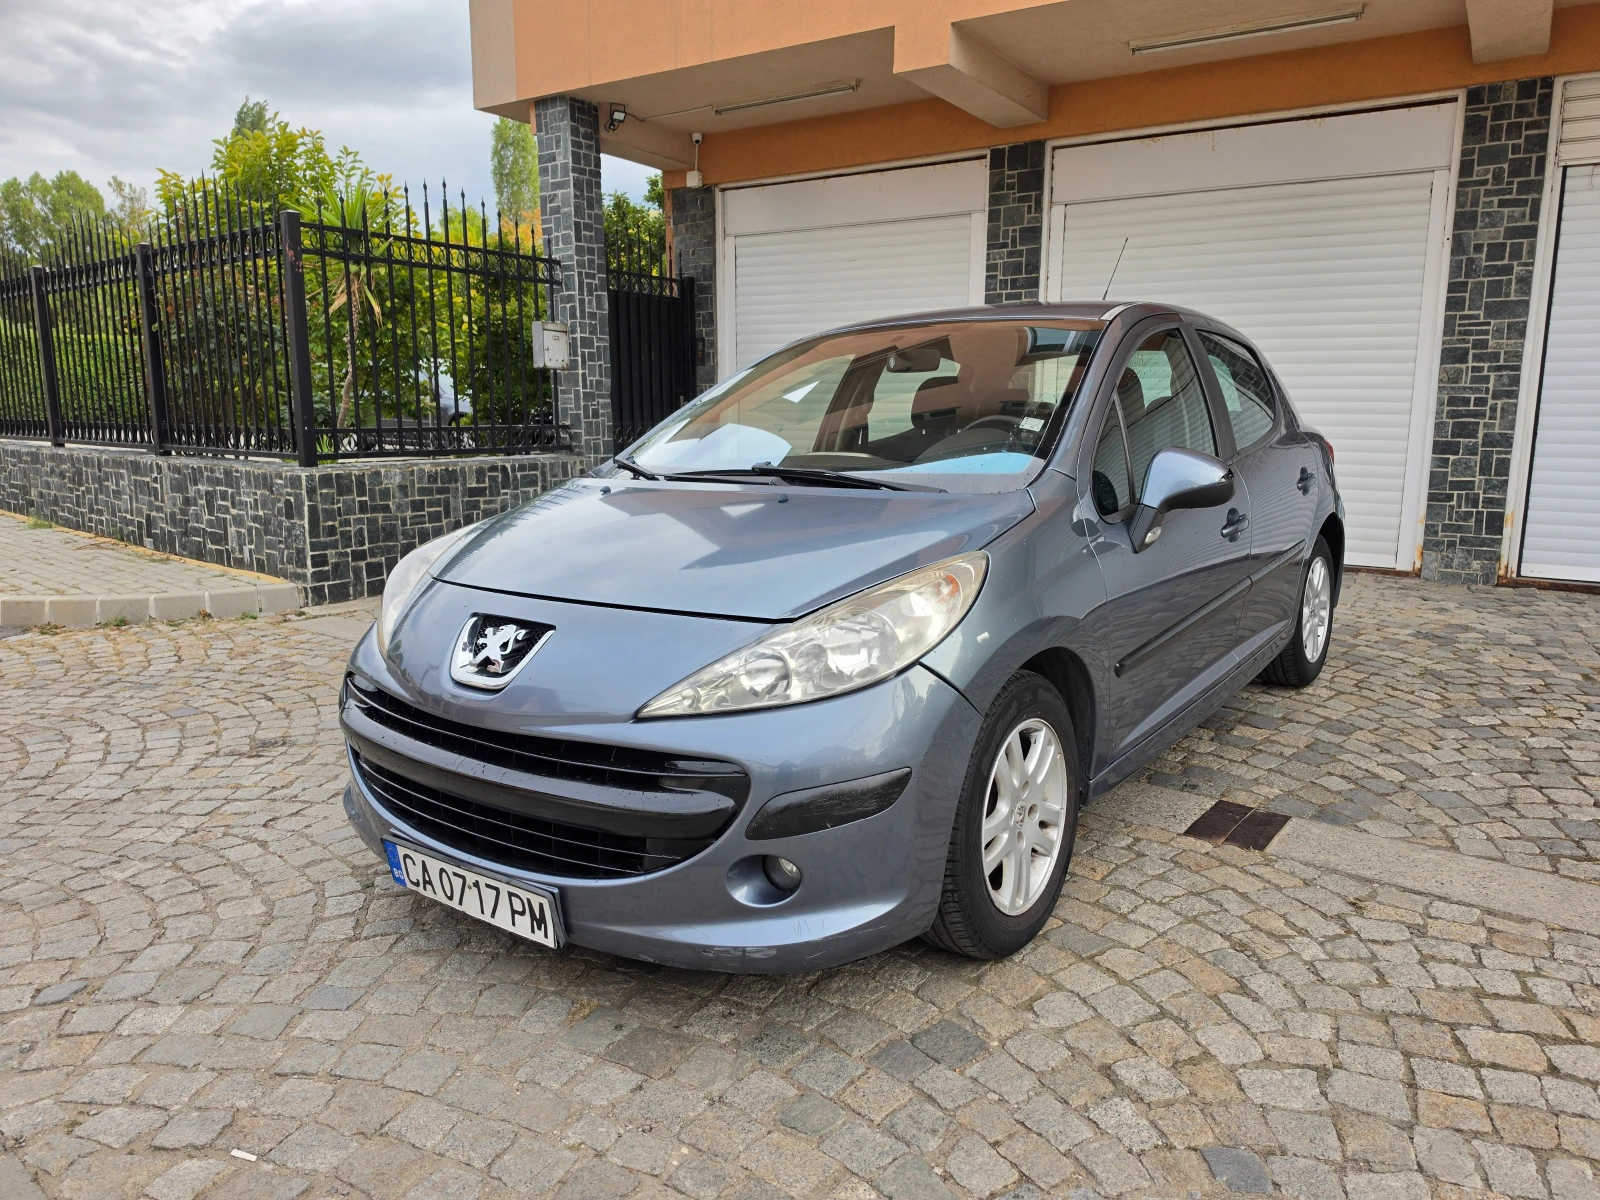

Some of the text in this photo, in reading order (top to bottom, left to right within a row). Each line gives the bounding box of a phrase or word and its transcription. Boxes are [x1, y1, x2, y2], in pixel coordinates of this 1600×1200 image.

[394, 868, 405, 880] BG
[403, 853, 548, 939] CA 0717 PM
